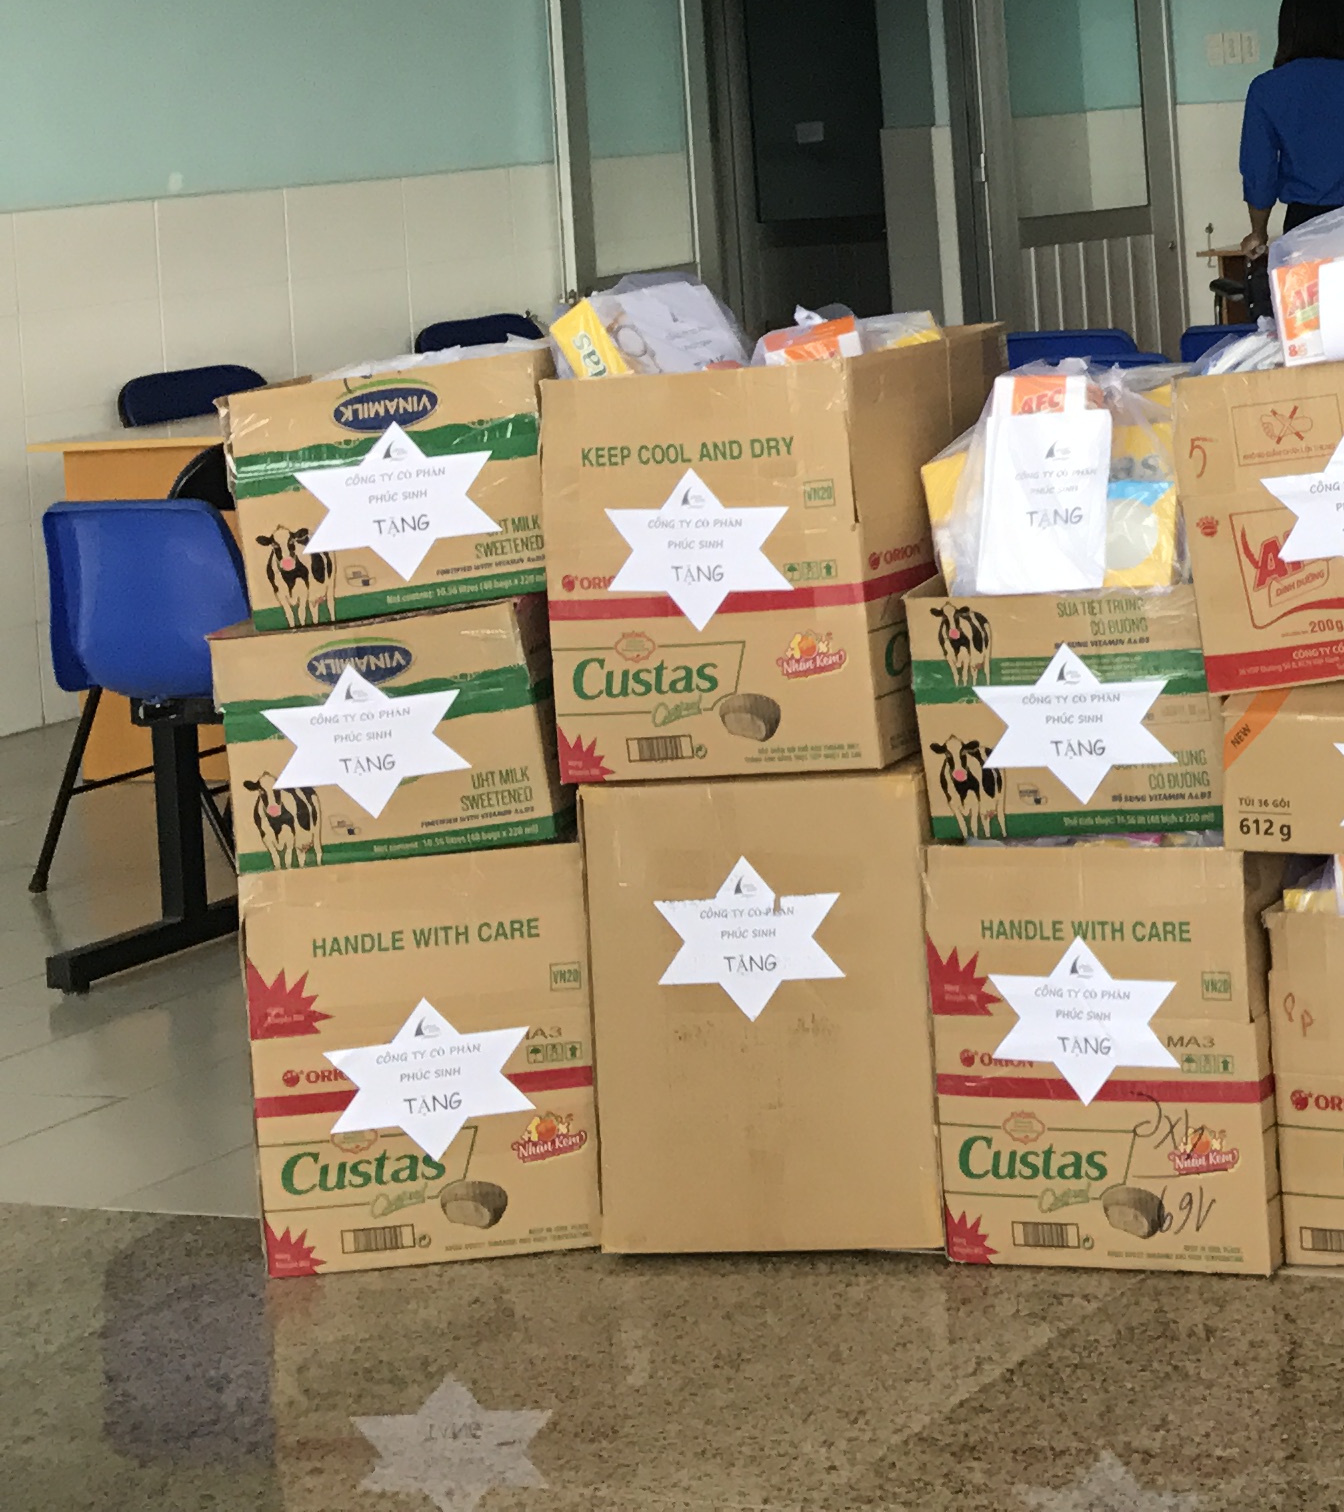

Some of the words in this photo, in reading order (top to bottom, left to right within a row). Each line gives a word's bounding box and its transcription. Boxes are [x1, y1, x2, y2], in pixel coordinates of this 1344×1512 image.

[340, 394, 432, 422] VINAMILK
[1017, 388, 1064, 414] AFC
[581, 443, 632, 468] KEEP
[637, 442, 691, 466] COOL
[700, 439, 742, 463] AND
[749, 436, 795, 459] DRY
[373, 513, 430, 538] TẶNG
[672, 563, 725, 587] TẶNG
[1308, 618, 1344, 636] 200g
[572, 657, 719, 700] Custas
[1229, 723, 1251, 749] NEW
[461, 785, 533, 812] SWEETENED
[312, 930, 404, 958] HANDLE
[413, 923, 470, 949] WITH
[478, 917, 540, 942] CARE
[1166, 1035, 1215, 1049] MA3
[403, 1090, 463, 1116] TẶNG
[958, 1135, 1108, 1181] Custas
[281, 1150, 447, 1196] Custas
